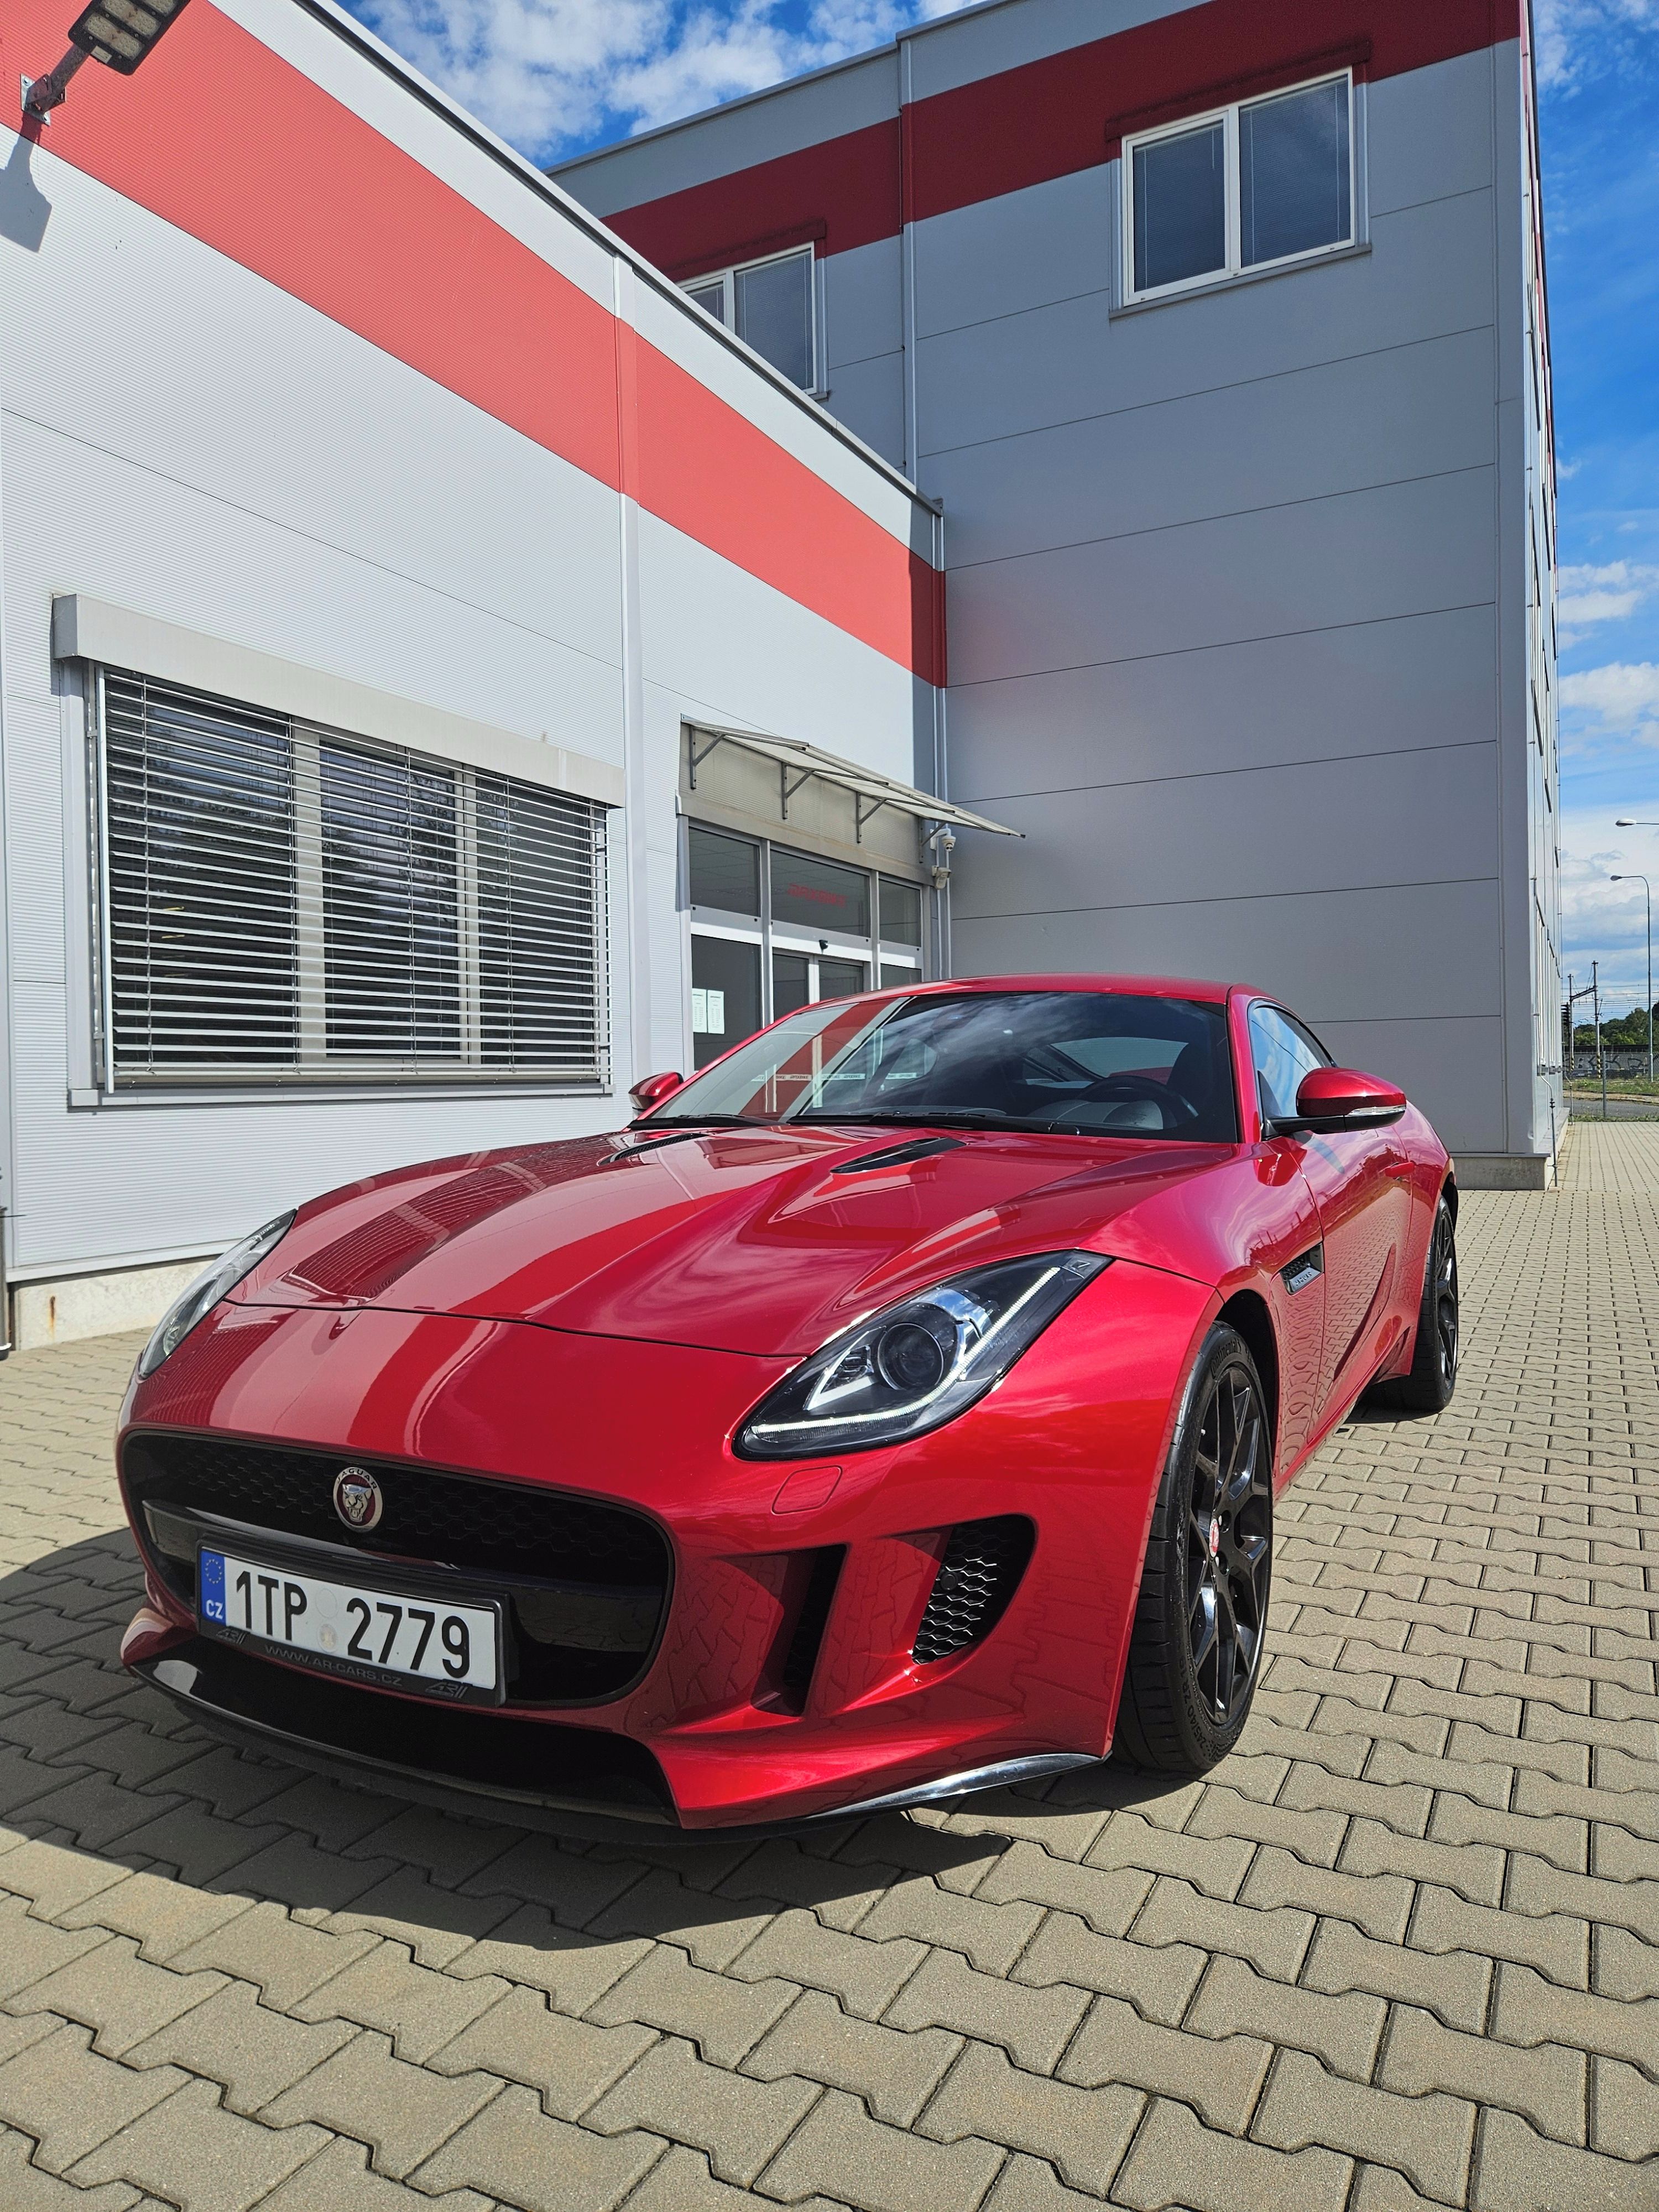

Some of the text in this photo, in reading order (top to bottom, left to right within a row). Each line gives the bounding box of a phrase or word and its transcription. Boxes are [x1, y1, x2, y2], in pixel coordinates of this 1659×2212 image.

[337, 1468, 377, 1490] JAGUAR
[205, 1599, 224, 1620] CZ
[236, 1571, 470, 1679] 1TP 2779
[264, 1644, 402, 1687] WWW.AR-CARS.CZ
